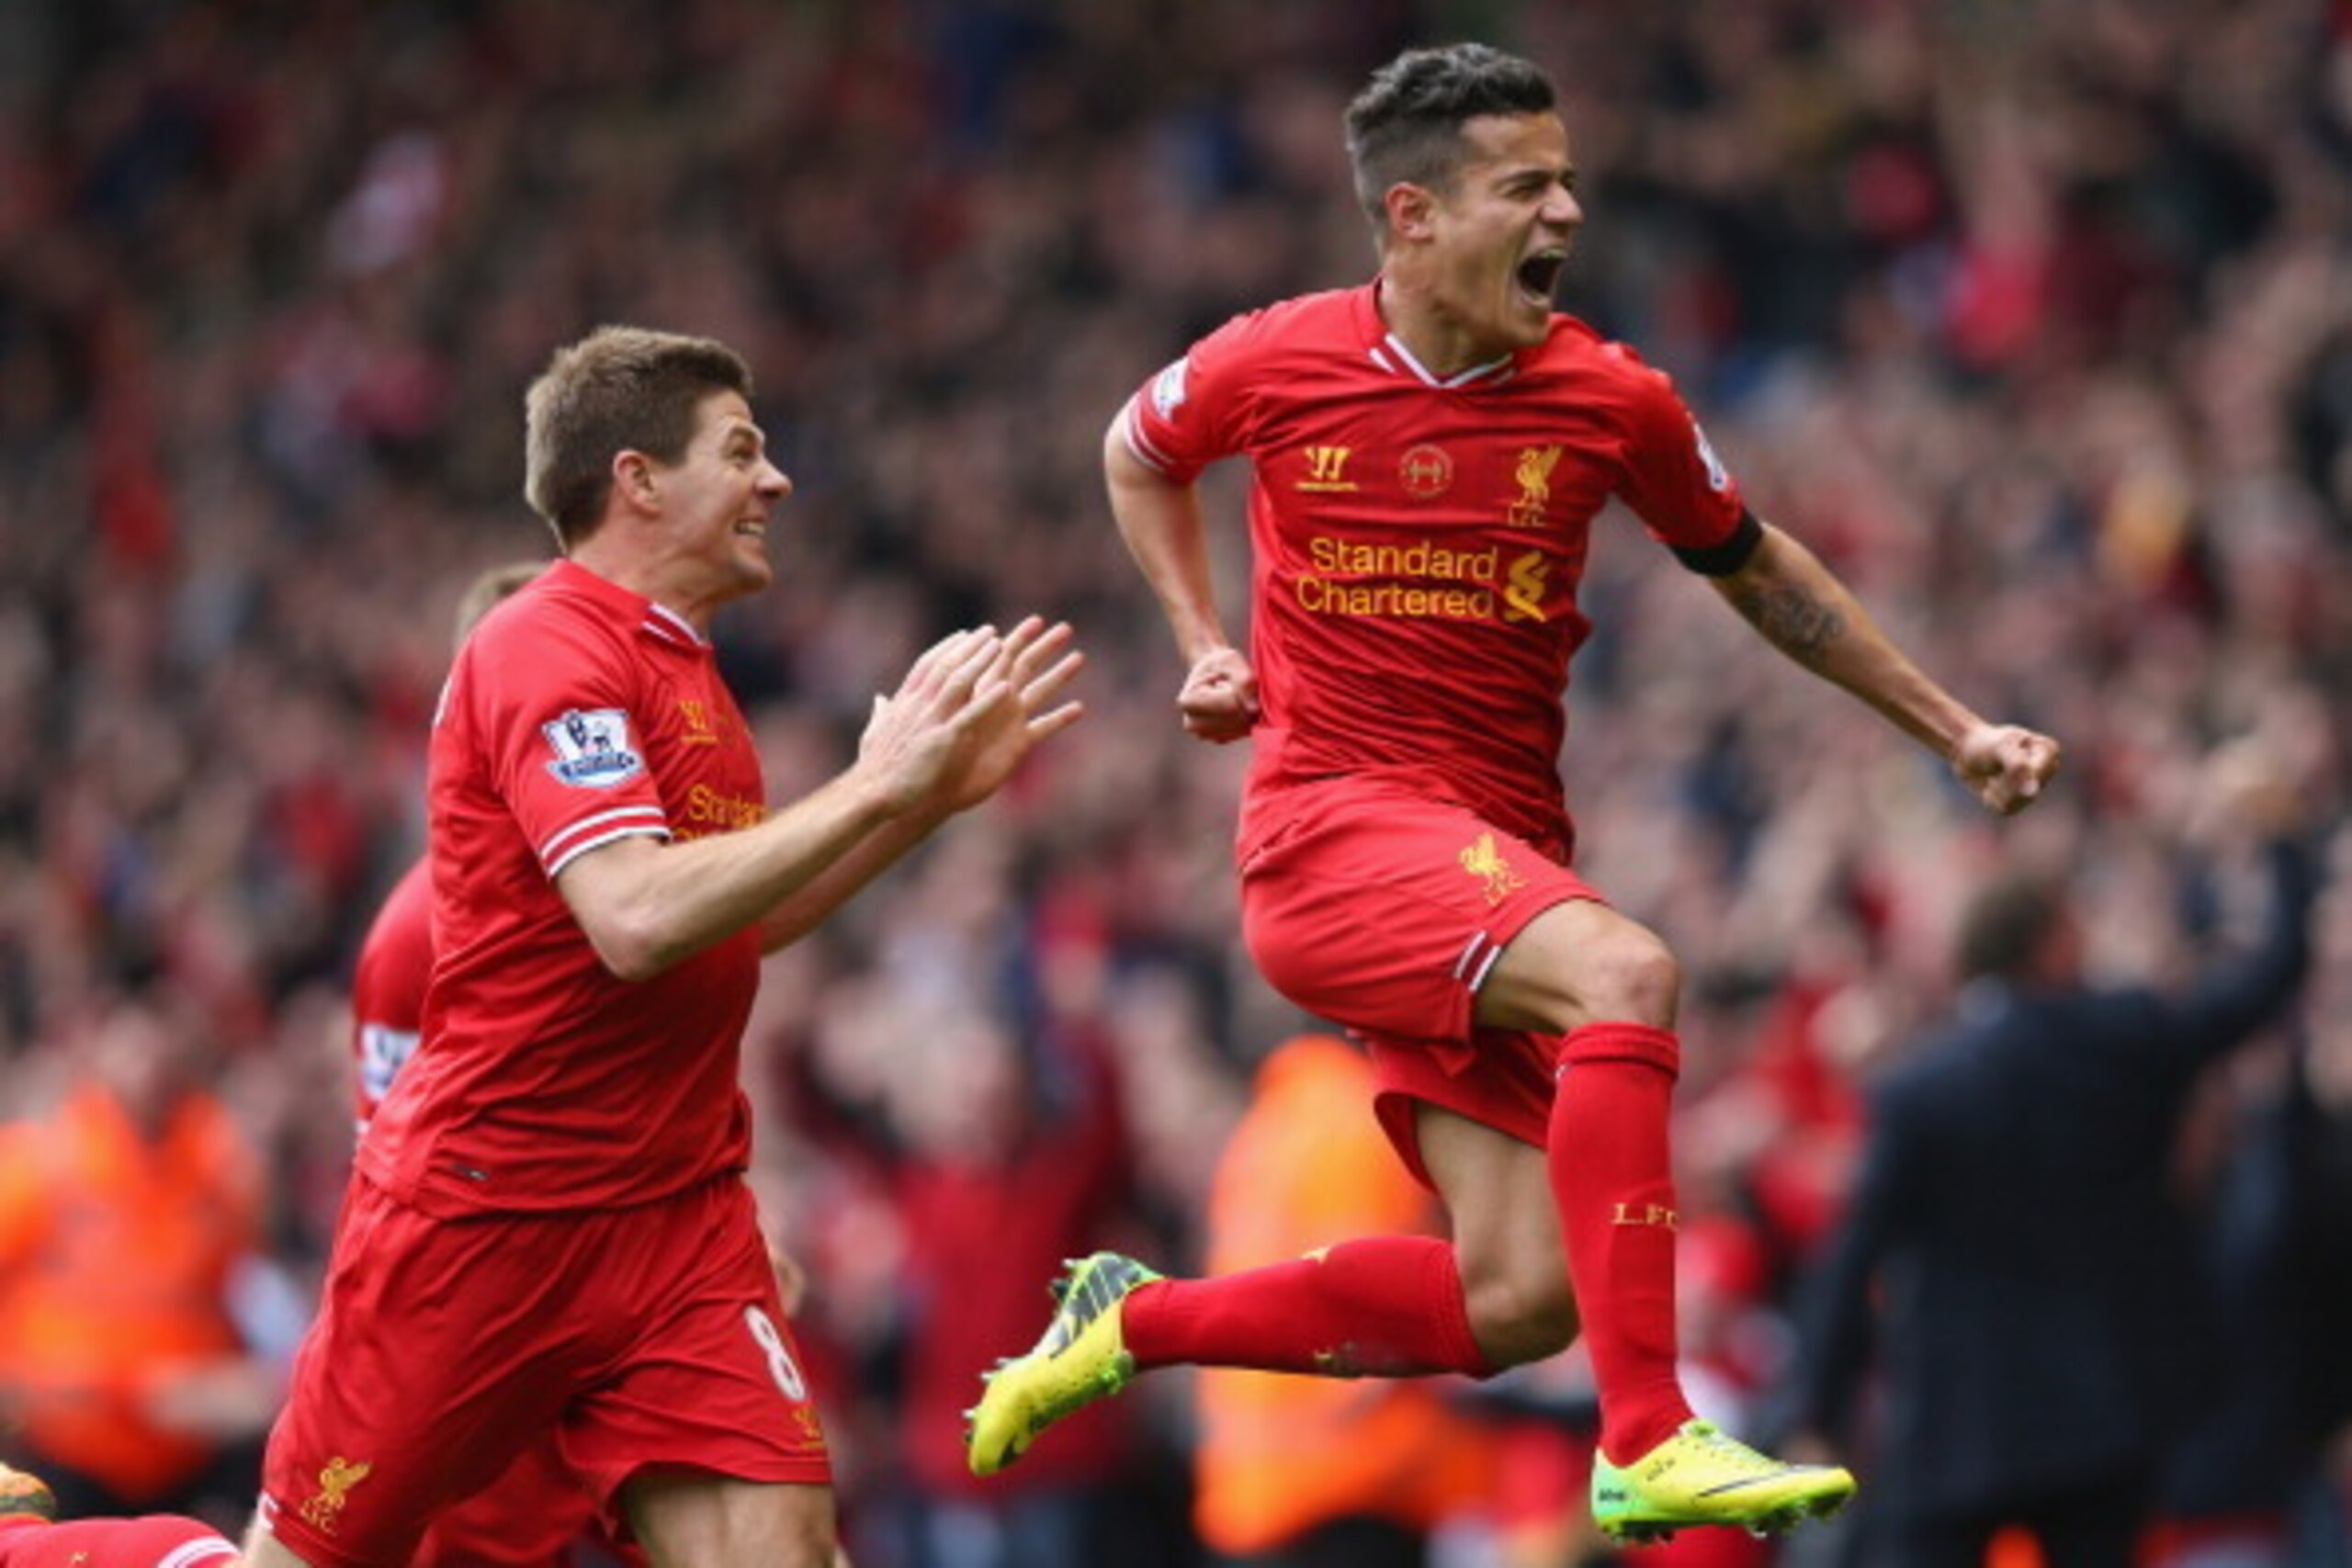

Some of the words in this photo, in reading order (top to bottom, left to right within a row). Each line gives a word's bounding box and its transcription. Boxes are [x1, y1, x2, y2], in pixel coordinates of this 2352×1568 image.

[1310, 537, 1498, 580] Standard
[1297, 575, 1495, 617] Chartered
[743, 1304, 807, 1402] 8
